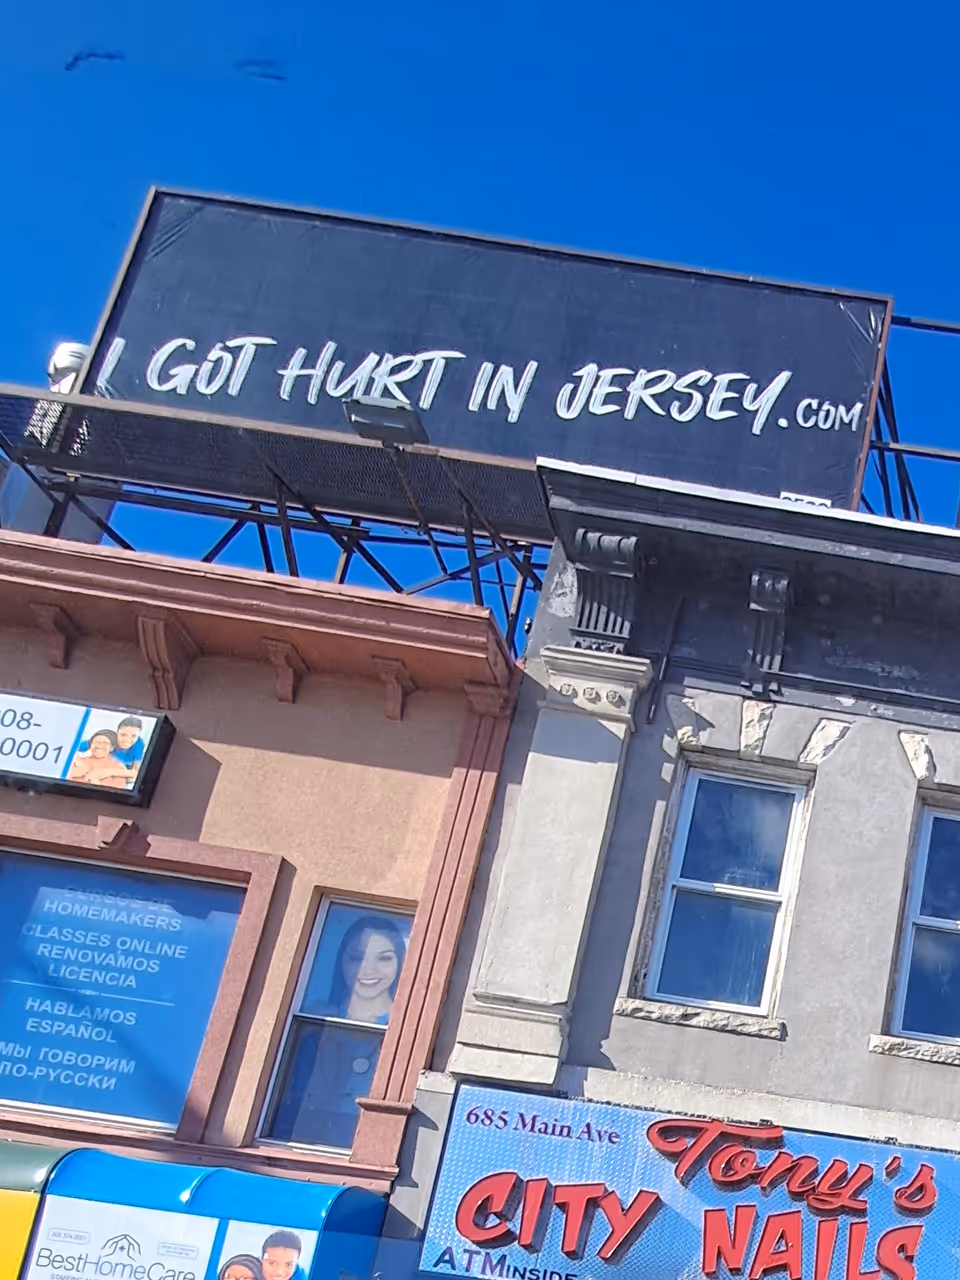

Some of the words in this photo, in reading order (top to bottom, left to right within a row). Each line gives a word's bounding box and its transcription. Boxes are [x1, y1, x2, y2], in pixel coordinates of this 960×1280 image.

[146, 336, 278, 397] GOT
[277, 340, 467, 411] HURT
[467, 360, 539, 424] IN
[0, 709, 42, 730] 08-
[0, 737, 63, 764] 0001
[43, 900, 182, 931] HOMEMAKERS
[22, 923, 111, 947] CLASSES
[116, 937, 188, 959] ONLINE
[37, 944, 160, 973] RENOVAMOS
[48, 964, 137, 989] LICENCIA
[25, 997, 137, 1026] HABLAMOS
[26, 1017, 117, 1043] ESPAÑOL
[0, 1041, 32, 1059] МЫ
[39, 1047, 136, 1074] ГОВОРИМ
[0, 1061, 117, 1090] ПО-РУССКИ
[465, 1105, 508, 1130] 685
[513, 1112, 573, 1139] Main
[577, 1121, 620, 1145] Ave
[647, 1118, 937, 1213] Tony's
[456, 1171, 662, 1261] CITY
